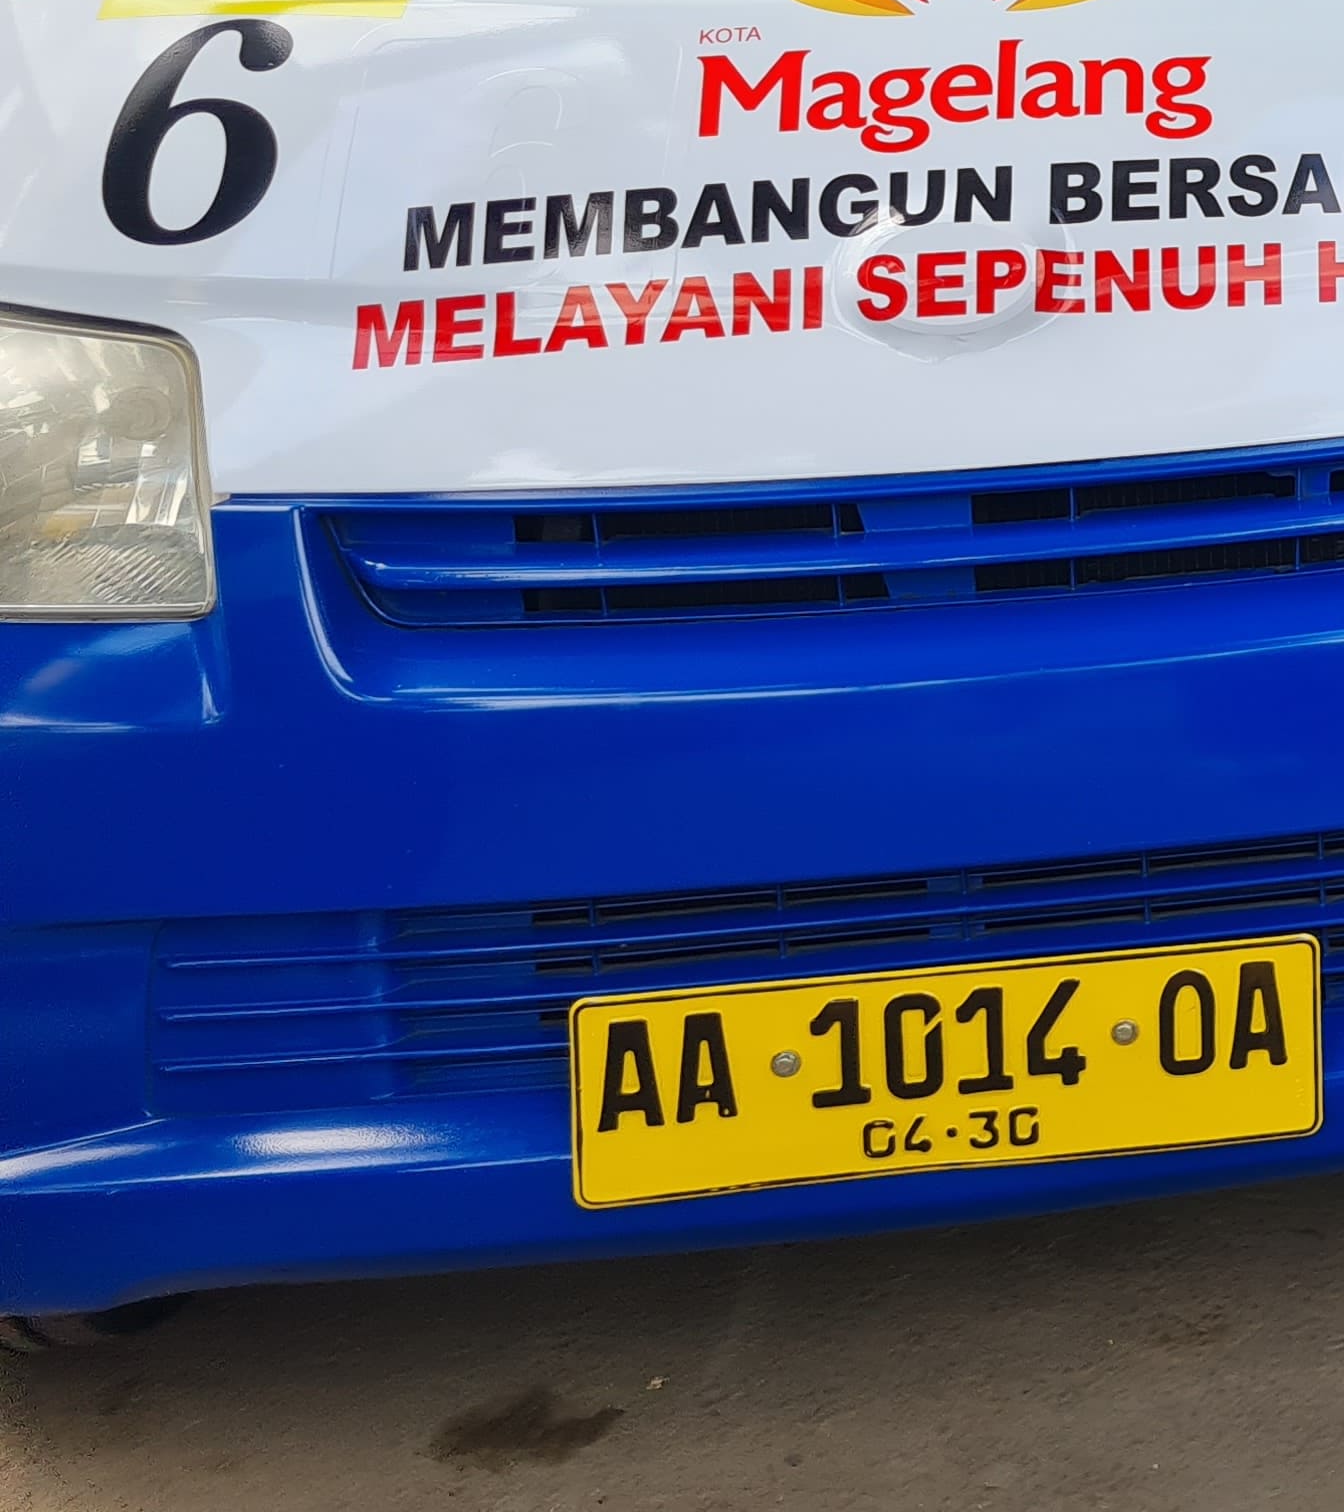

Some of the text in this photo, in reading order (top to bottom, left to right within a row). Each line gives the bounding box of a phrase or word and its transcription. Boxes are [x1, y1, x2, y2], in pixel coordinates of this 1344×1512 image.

[698, 26, 762, 44] KOTA
[101, 19, 294, 246] 6
[698, 39, 1214, 154] Magelang
[403, 165, 1013, 272] MEMBANGUN
[351, 266, 825, 371] MELAYANI
[855, 243, 1284, 324] SEPENUH
[597, 1012, 738, 1134] AA
[809, 978, 1087, 1110] 1014
